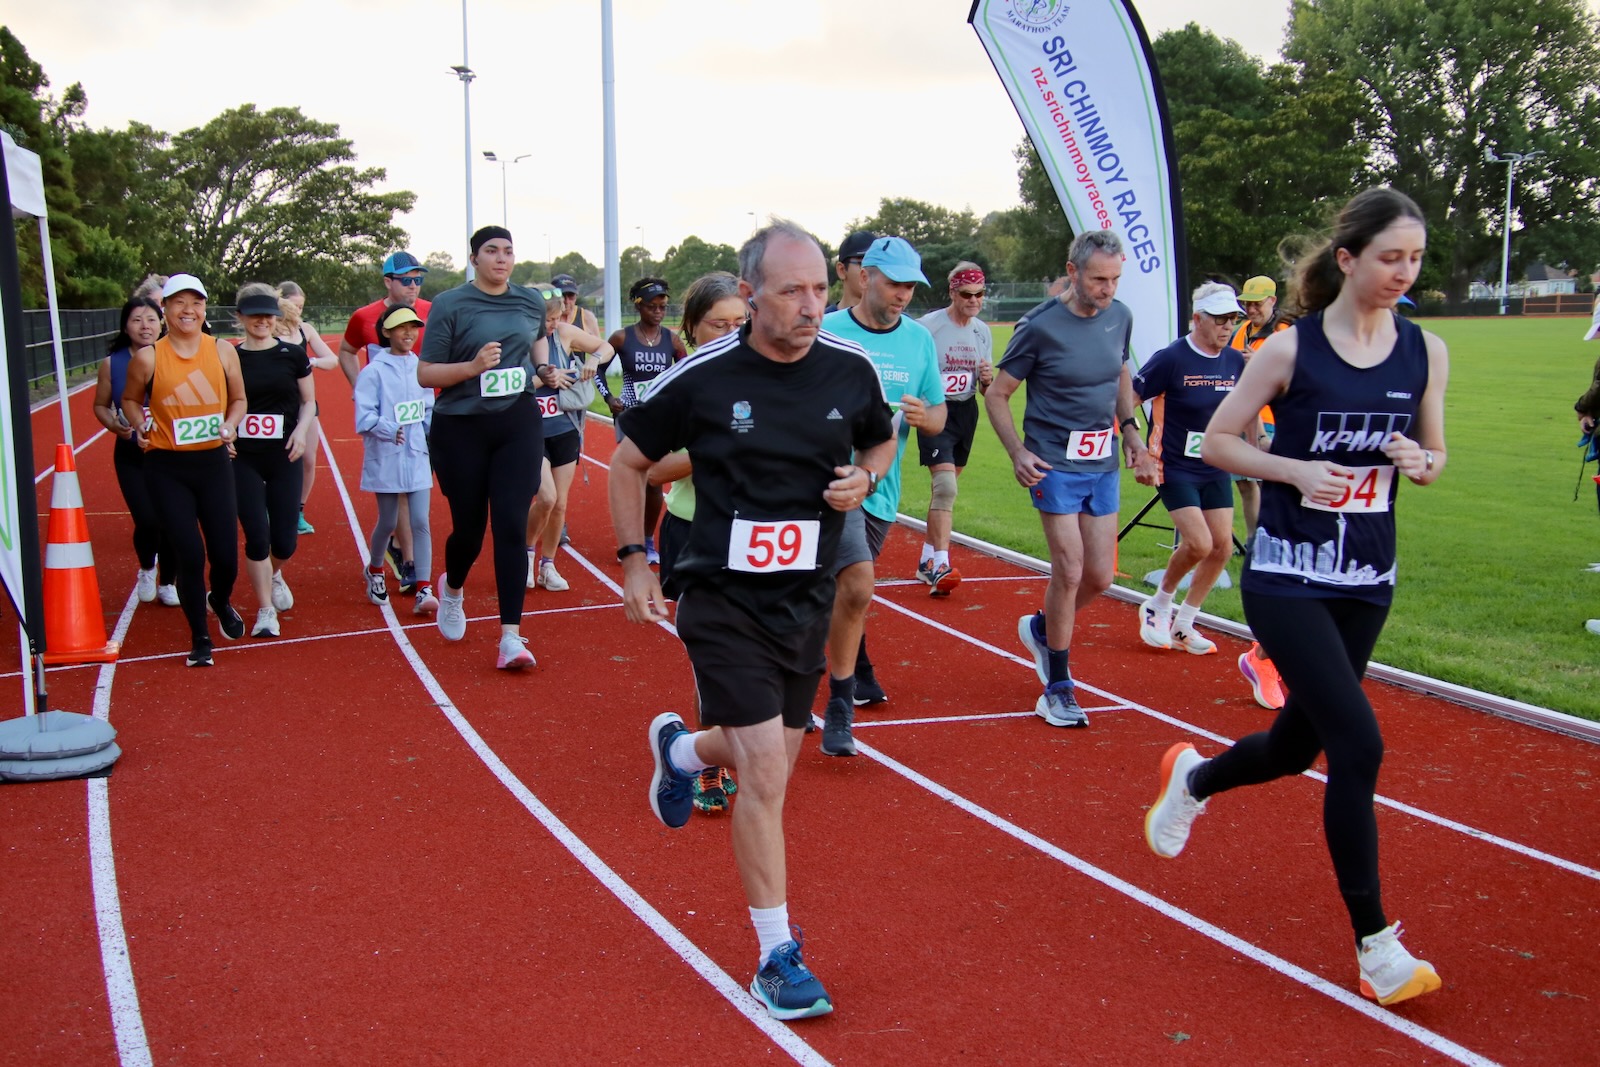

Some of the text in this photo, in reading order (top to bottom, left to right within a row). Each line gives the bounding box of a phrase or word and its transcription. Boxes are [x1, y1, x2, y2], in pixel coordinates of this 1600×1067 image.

[1006, 5, 1071, 34] MARATHON TEAM
[1031, 66, 1113, 230] nz.srichinmoyraces
[1042, 35, 1160, 274] SRI CHINMOY RACES
[634, 351, 667, 364] RUN
[634, 364, 666, 373] MORE
[485, 371, 522, 393] 218
[883, 370, 910, 383] SERIES
[946, 375, 968, 393] 29
[396, 401, 424, 422] 220
[177, 416, 221, 442] 228
[245, 415, 277, 437] 69
[1077, 431, 1110, 457] 57
[746, 524, 803, 568] 59
